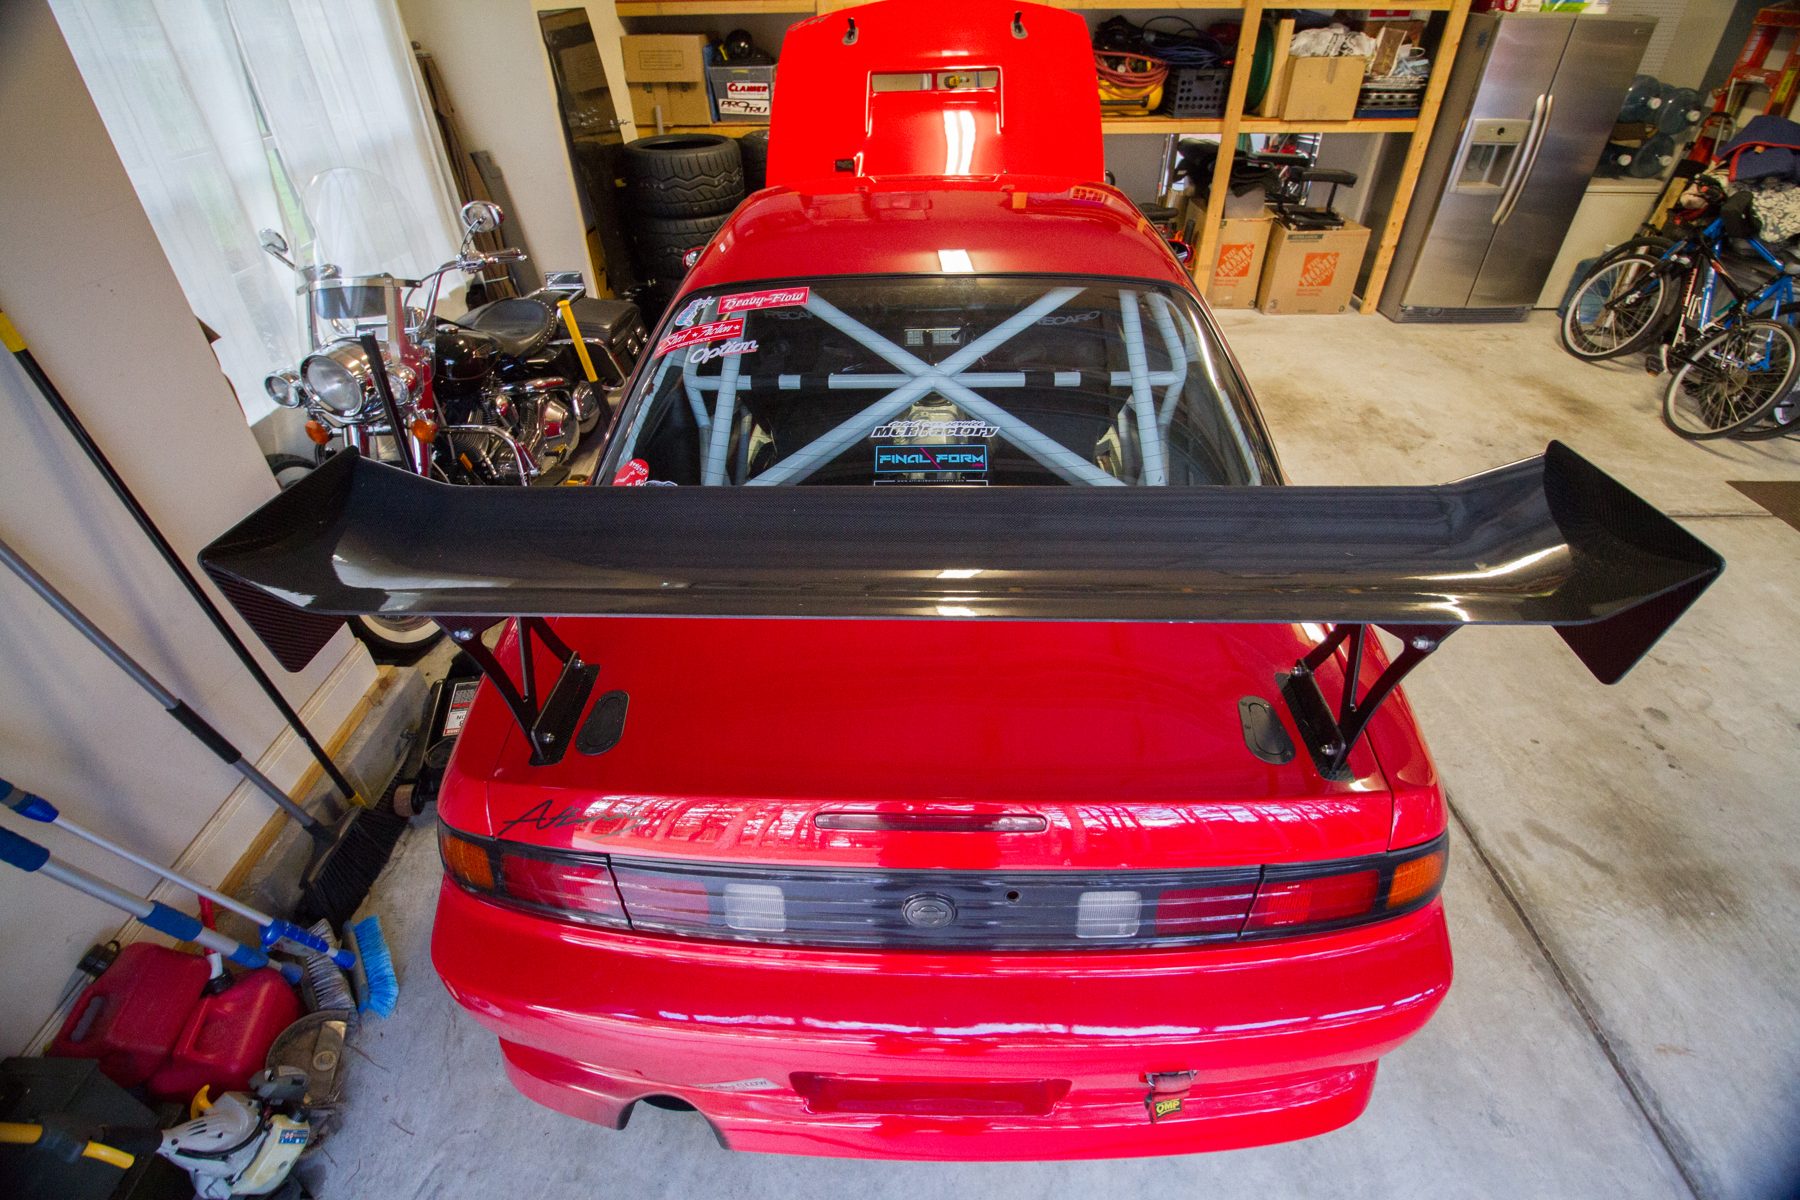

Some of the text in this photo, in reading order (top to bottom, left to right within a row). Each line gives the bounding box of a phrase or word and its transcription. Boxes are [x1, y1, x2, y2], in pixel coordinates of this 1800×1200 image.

[1216, 243, 1253, 276] HOME
[1301, 253, 1338, 286] HOME
[764, 310, 813, 320] RECA
[1037, 310, 1100, 326] ECARO
[690, 340, 760, 364] Option
[871, 426, 1000, 438] MCR Factory
[879, 454, 984, 464] FINAL FORM
[1156, 1100, 1180, 1114] OMP
